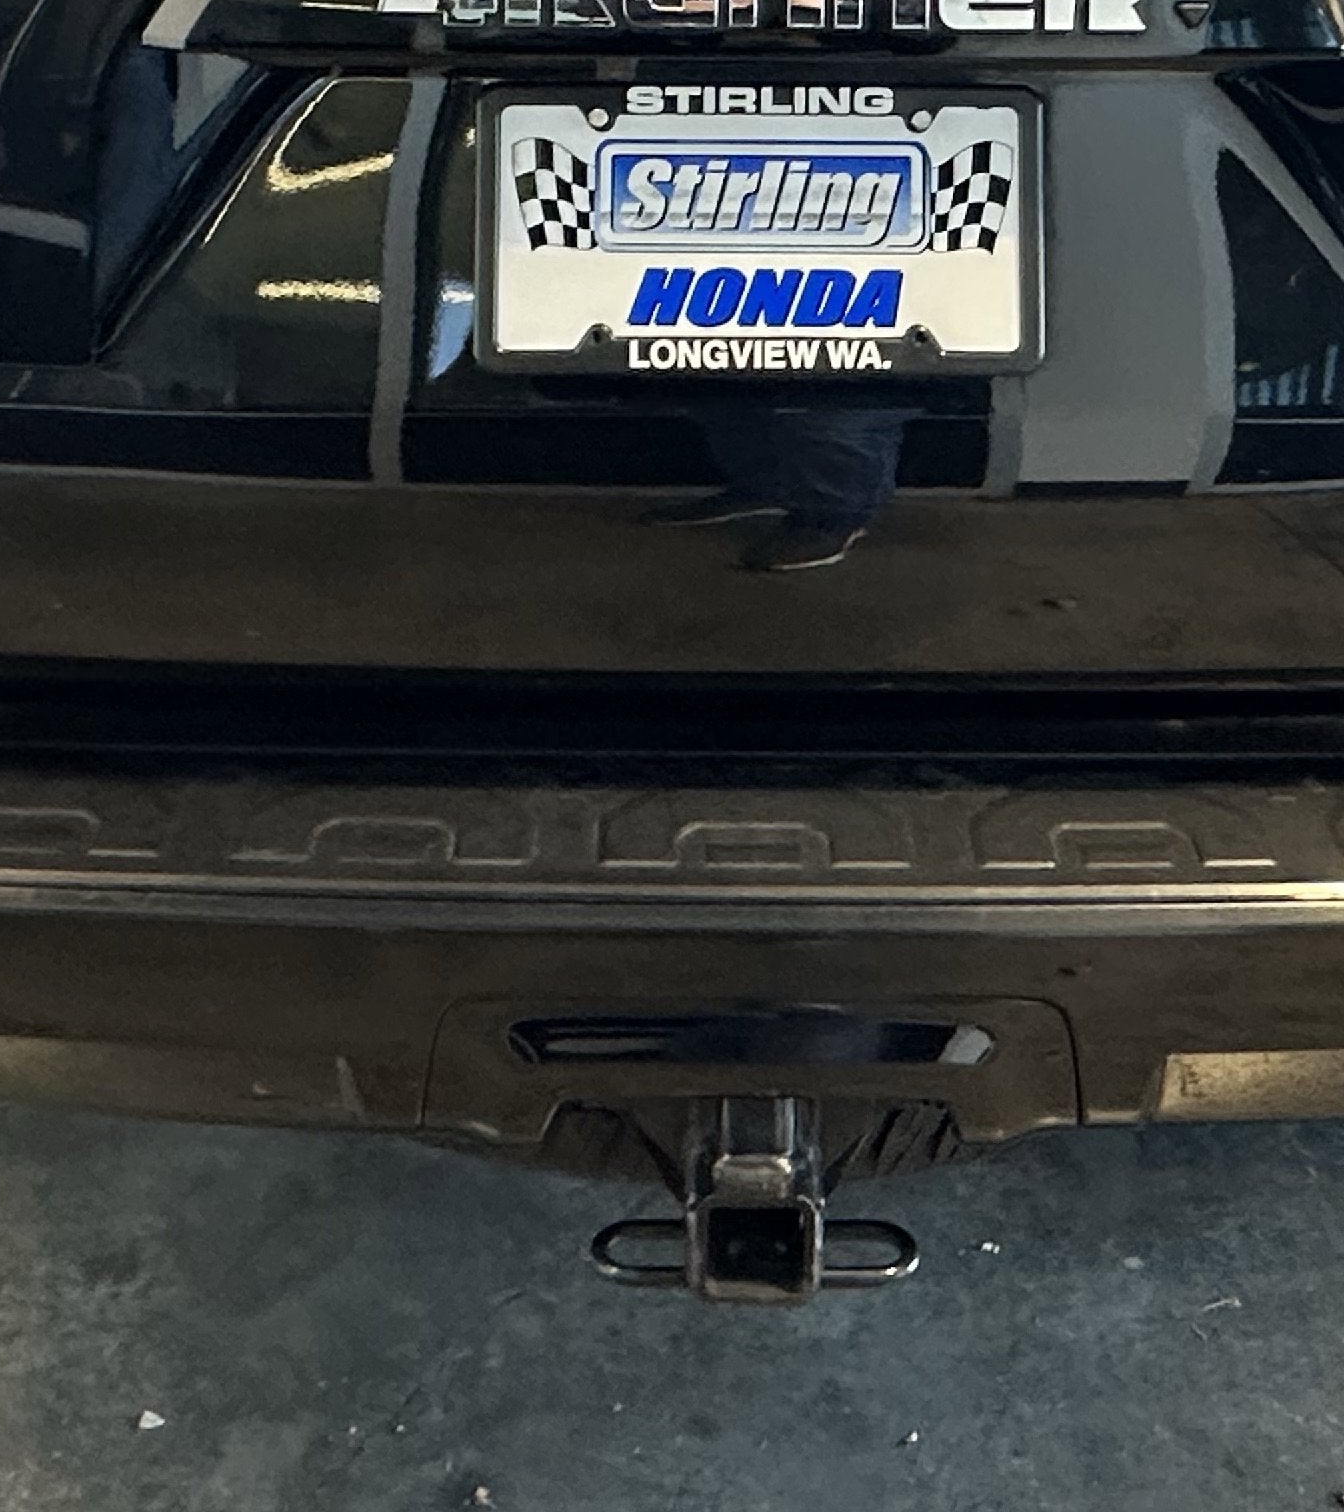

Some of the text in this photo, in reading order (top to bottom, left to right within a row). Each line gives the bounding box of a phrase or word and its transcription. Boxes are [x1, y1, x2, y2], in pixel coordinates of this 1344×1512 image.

[625, 85, 895, 115] STIRLING
[620, 157, 903, 248] Stirling
[626, 267, 904, 328] HONDA
[627, 338, 893, 371] LONGVIEW WA.
